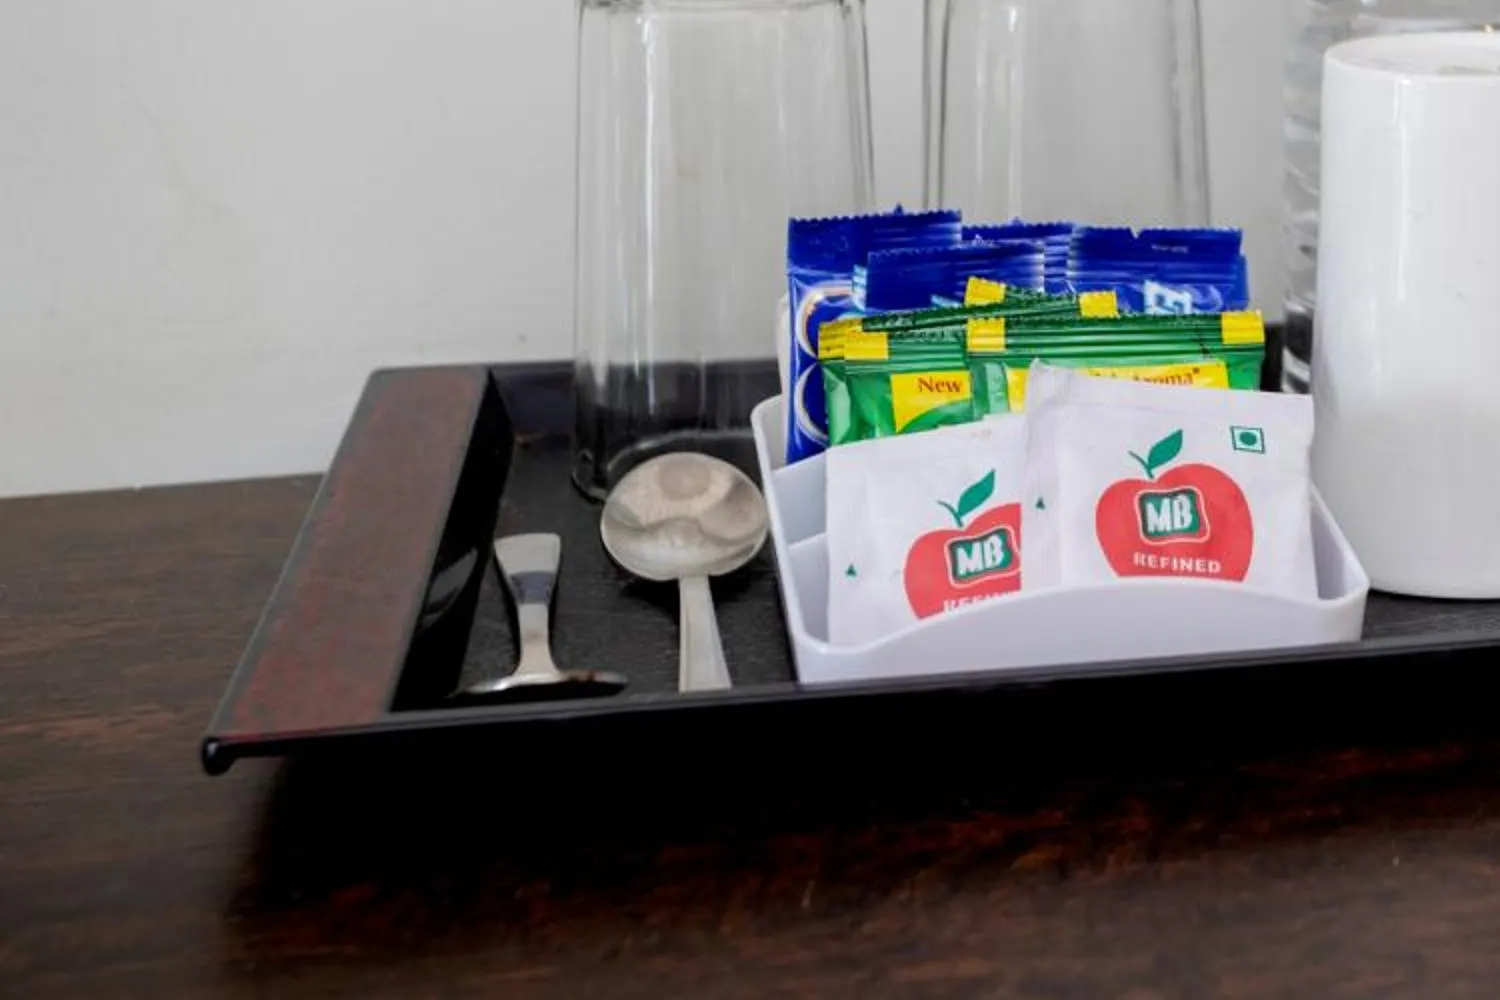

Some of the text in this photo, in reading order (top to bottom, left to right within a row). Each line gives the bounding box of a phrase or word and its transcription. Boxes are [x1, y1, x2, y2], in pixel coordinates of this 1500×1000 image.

[917, 376, 962, 395] New
[1145, 494, 1193, 534] MB
[955, 535, 1005, 576] MB
[1132, 551, 1222, 574] REFINED
